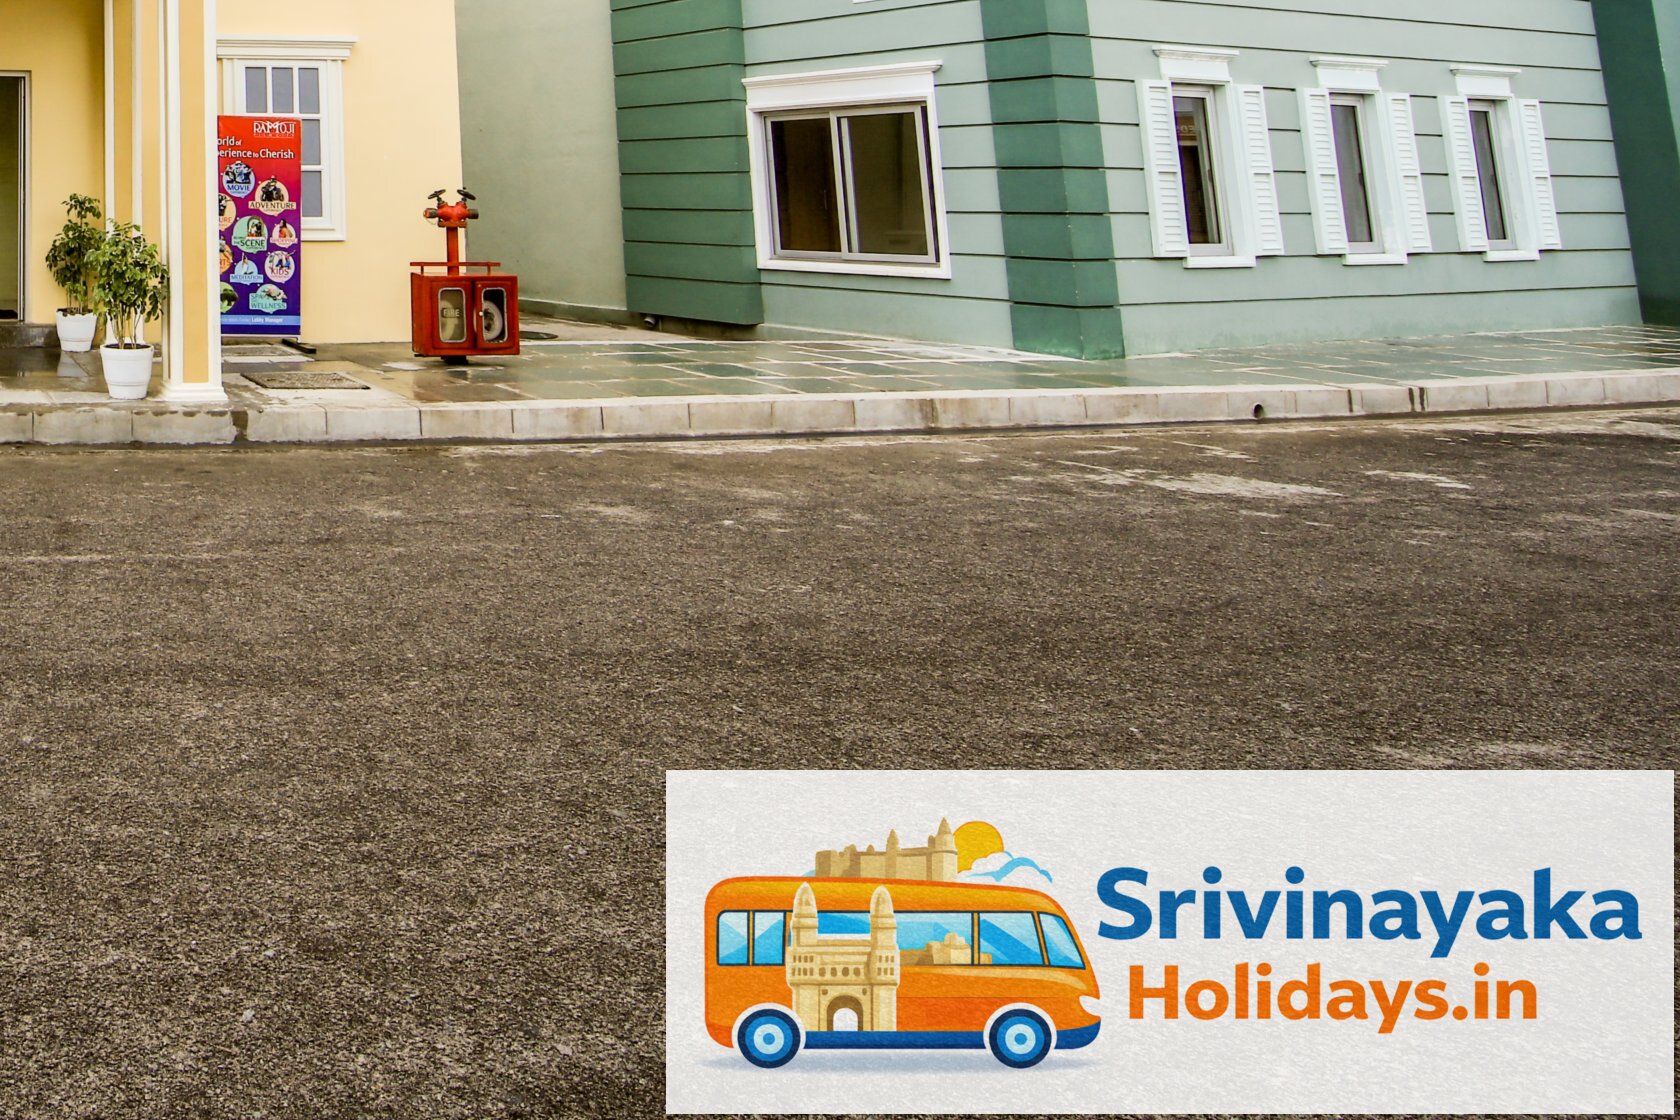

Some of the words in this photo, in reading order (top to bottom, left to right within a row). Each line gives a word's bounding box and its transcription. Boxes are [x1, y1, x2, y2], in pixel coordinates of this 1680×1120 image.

[254, 121, 296, 133] RAMOJI
[217, 136, 235, 146] orld
[218, 148, 253, 158] erience
[260, 148, 294, 159] Cherish
[227, 184, 251, 192] MOVIE
[250, 201, 295, 209] ADVENTURE
[240, 239, 266, 247] SCENE
[270, 267, 290, 276] KIDS
